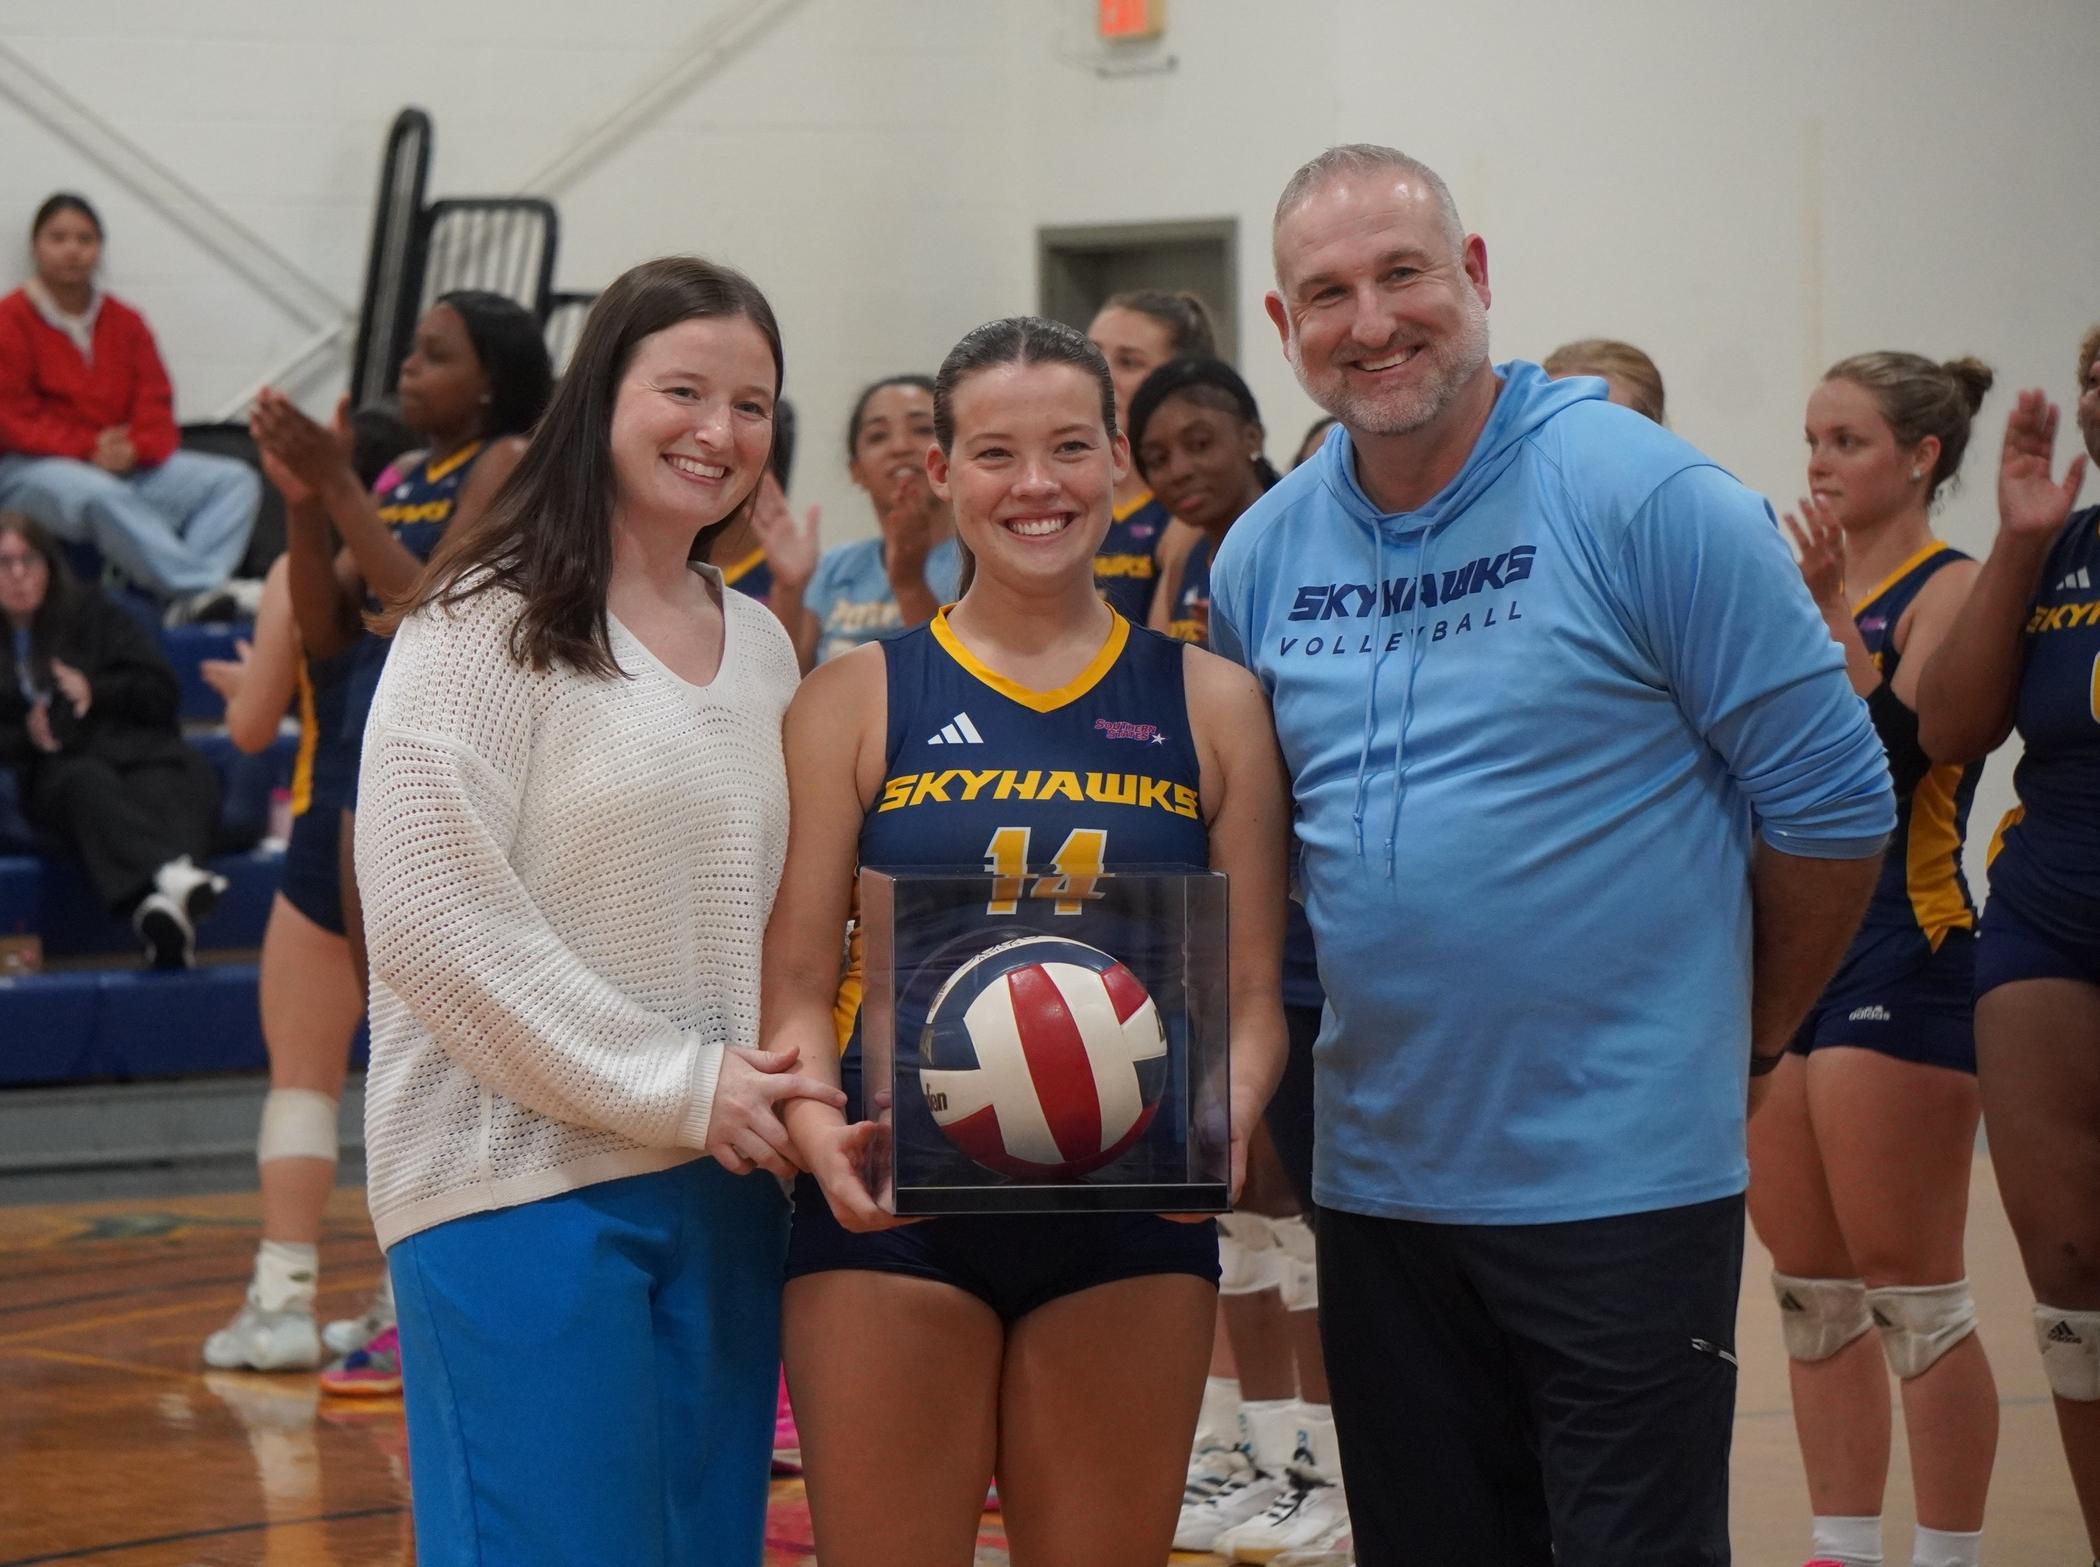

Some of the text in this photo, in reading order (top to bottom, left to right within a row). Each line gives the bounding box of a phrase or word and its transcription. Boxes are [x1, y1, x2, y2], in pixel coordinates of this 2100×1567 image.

[1288, 545, 1537, 621] SKYHAWKS
[878, 769, 1199, 820] SKYHAWKS
[984, 826, 1108, 915] 14
